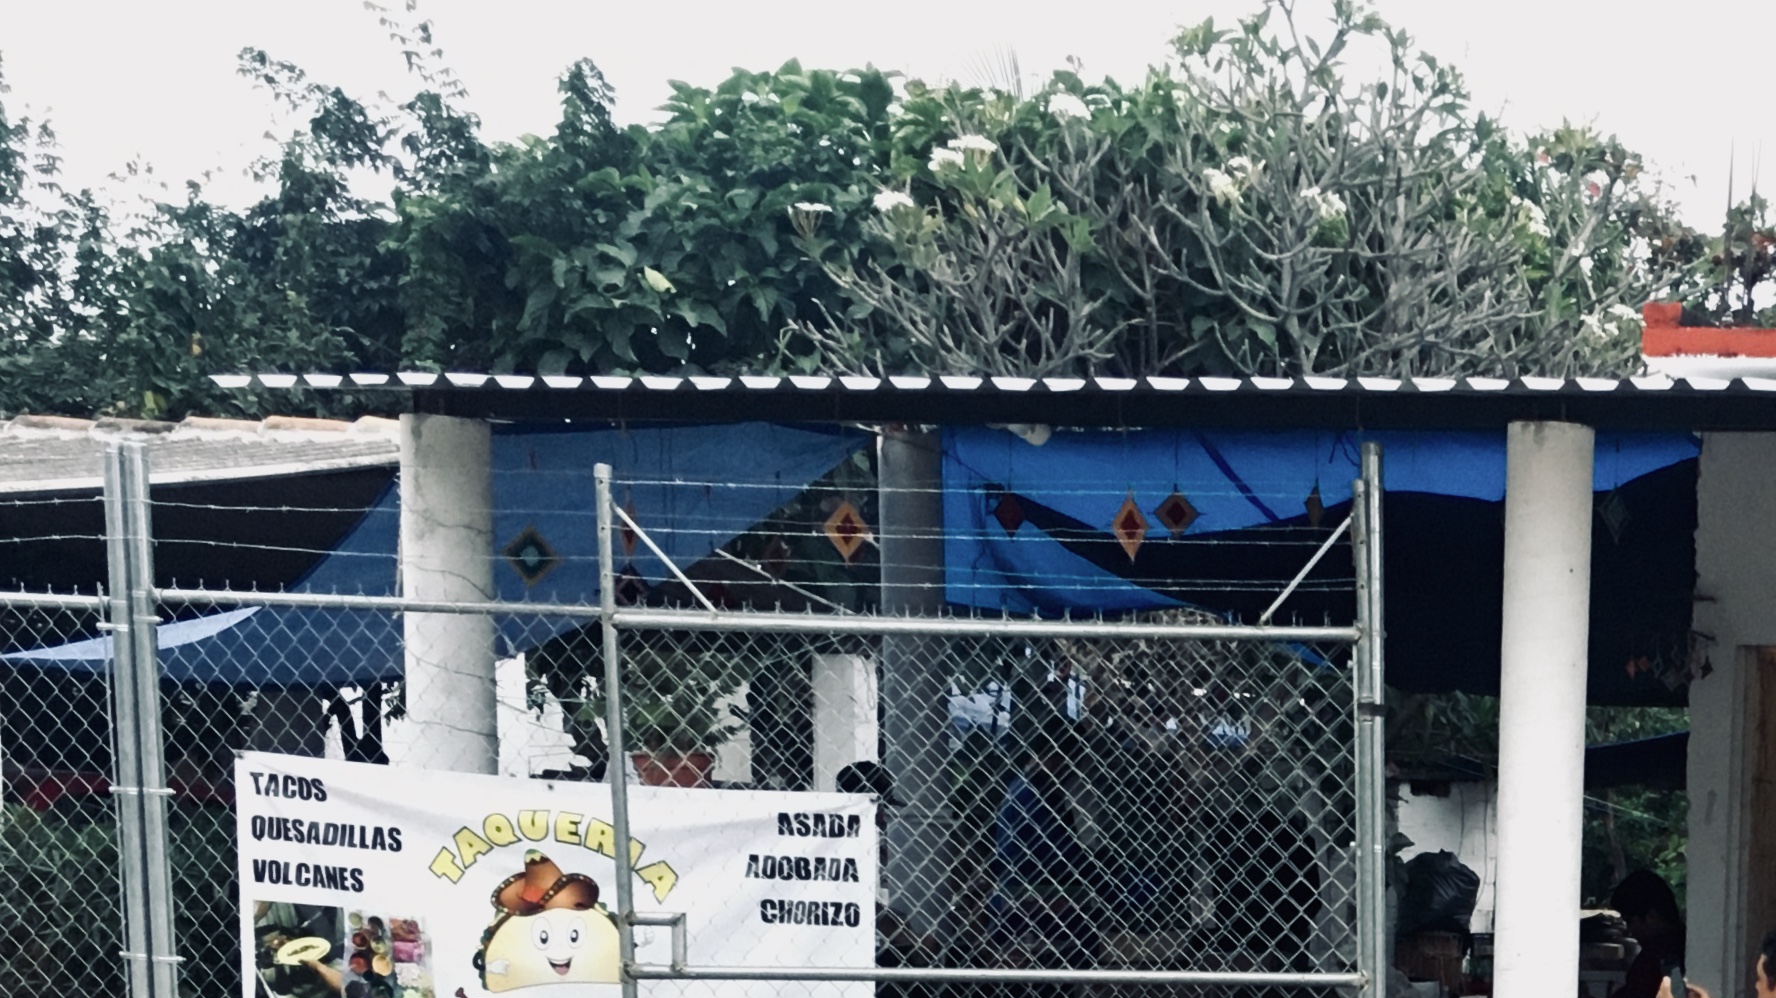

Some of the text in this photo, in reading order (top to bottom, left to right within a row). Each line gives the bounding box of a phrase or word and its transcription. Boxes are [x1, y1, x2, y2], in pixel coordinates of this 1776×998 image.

[249, 771, 327, 802] TACOS
[251, 815, 402, 852] QUESADILLAS
[777, 812, 861, 838] ASADA
[428, 809, 679, 904] TAQUERIA
[745, 854, 859, 882] ADOBADA
[252, 858, 364, 893] VOLCANES
[760, 898, 860, 927] CHORIZO
